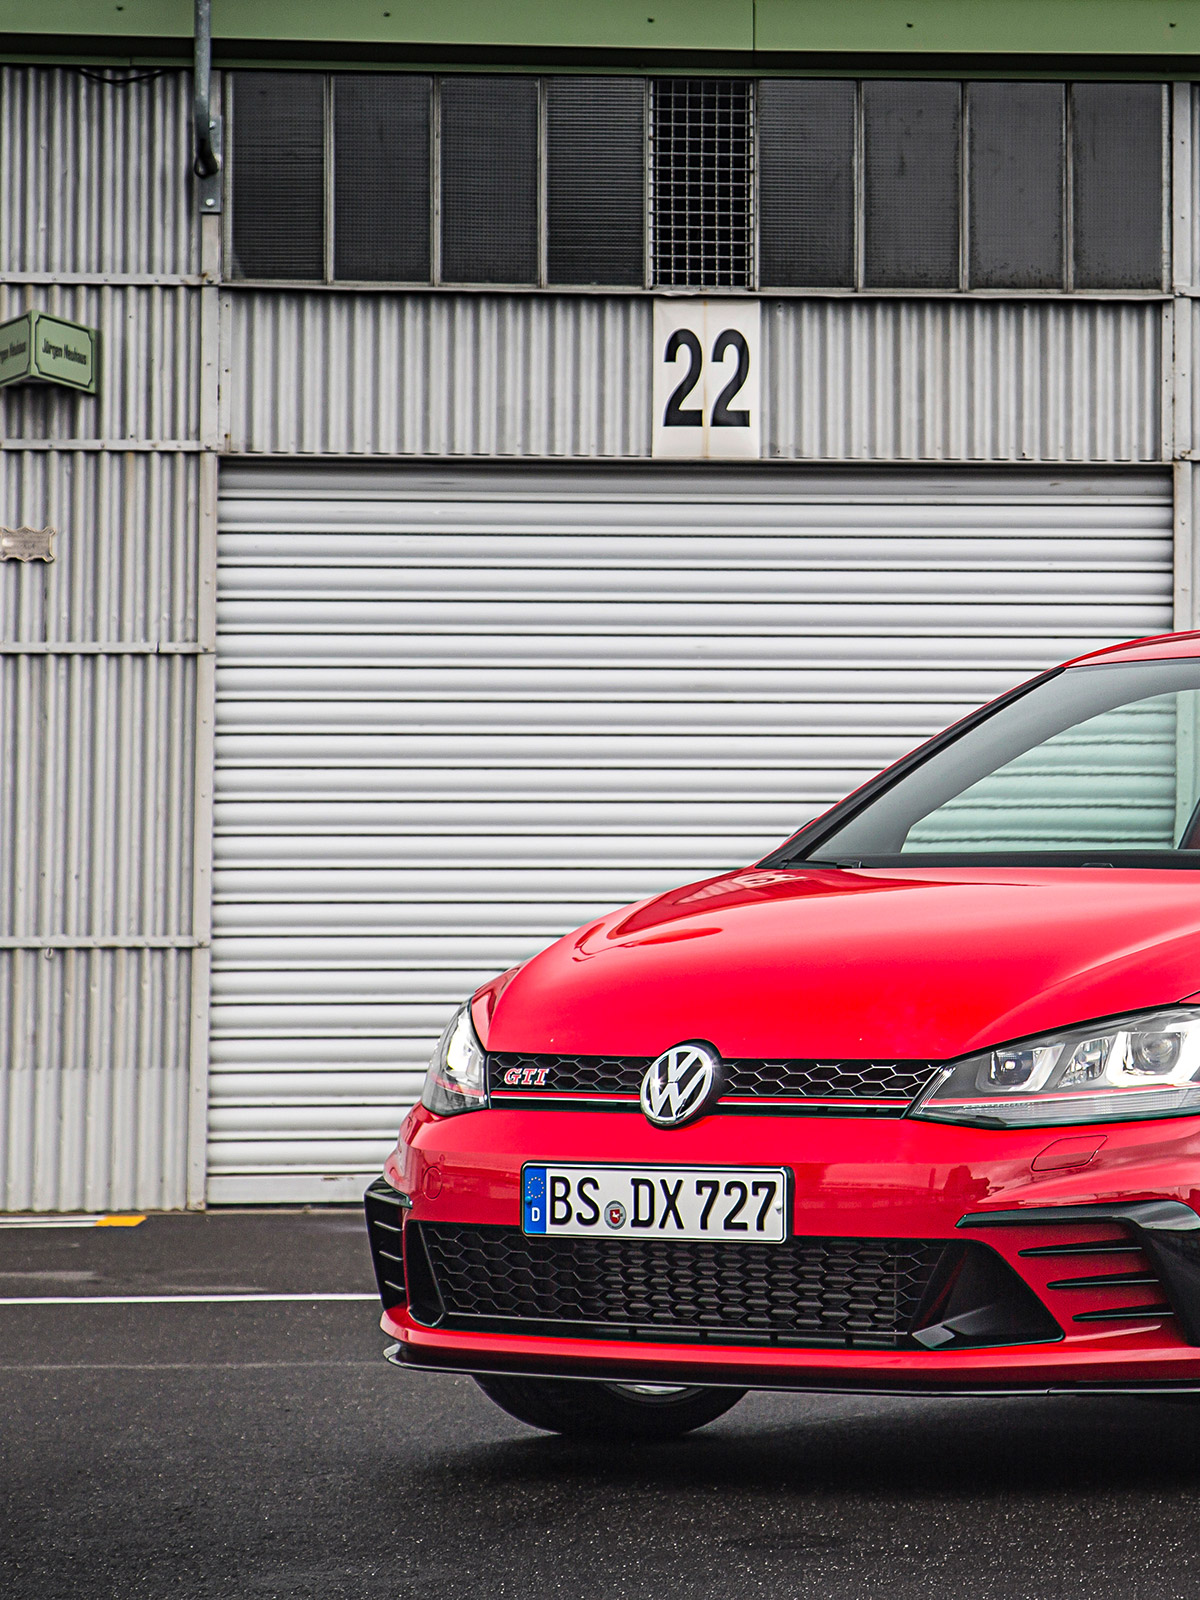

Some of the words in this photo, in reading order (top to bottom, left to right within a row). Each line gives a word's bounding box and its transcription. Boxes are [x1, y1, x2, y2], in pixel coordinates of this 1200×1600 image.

[663, 328, 751, 427] 22
[504, 1067, 550, 1086] GTI
[531, 1207, 540, 1222] D
[550, 1175, 600, 1226] BS
[631, 1177, 684, 1230] DX
[695, 1179, 777, 1232] 727
